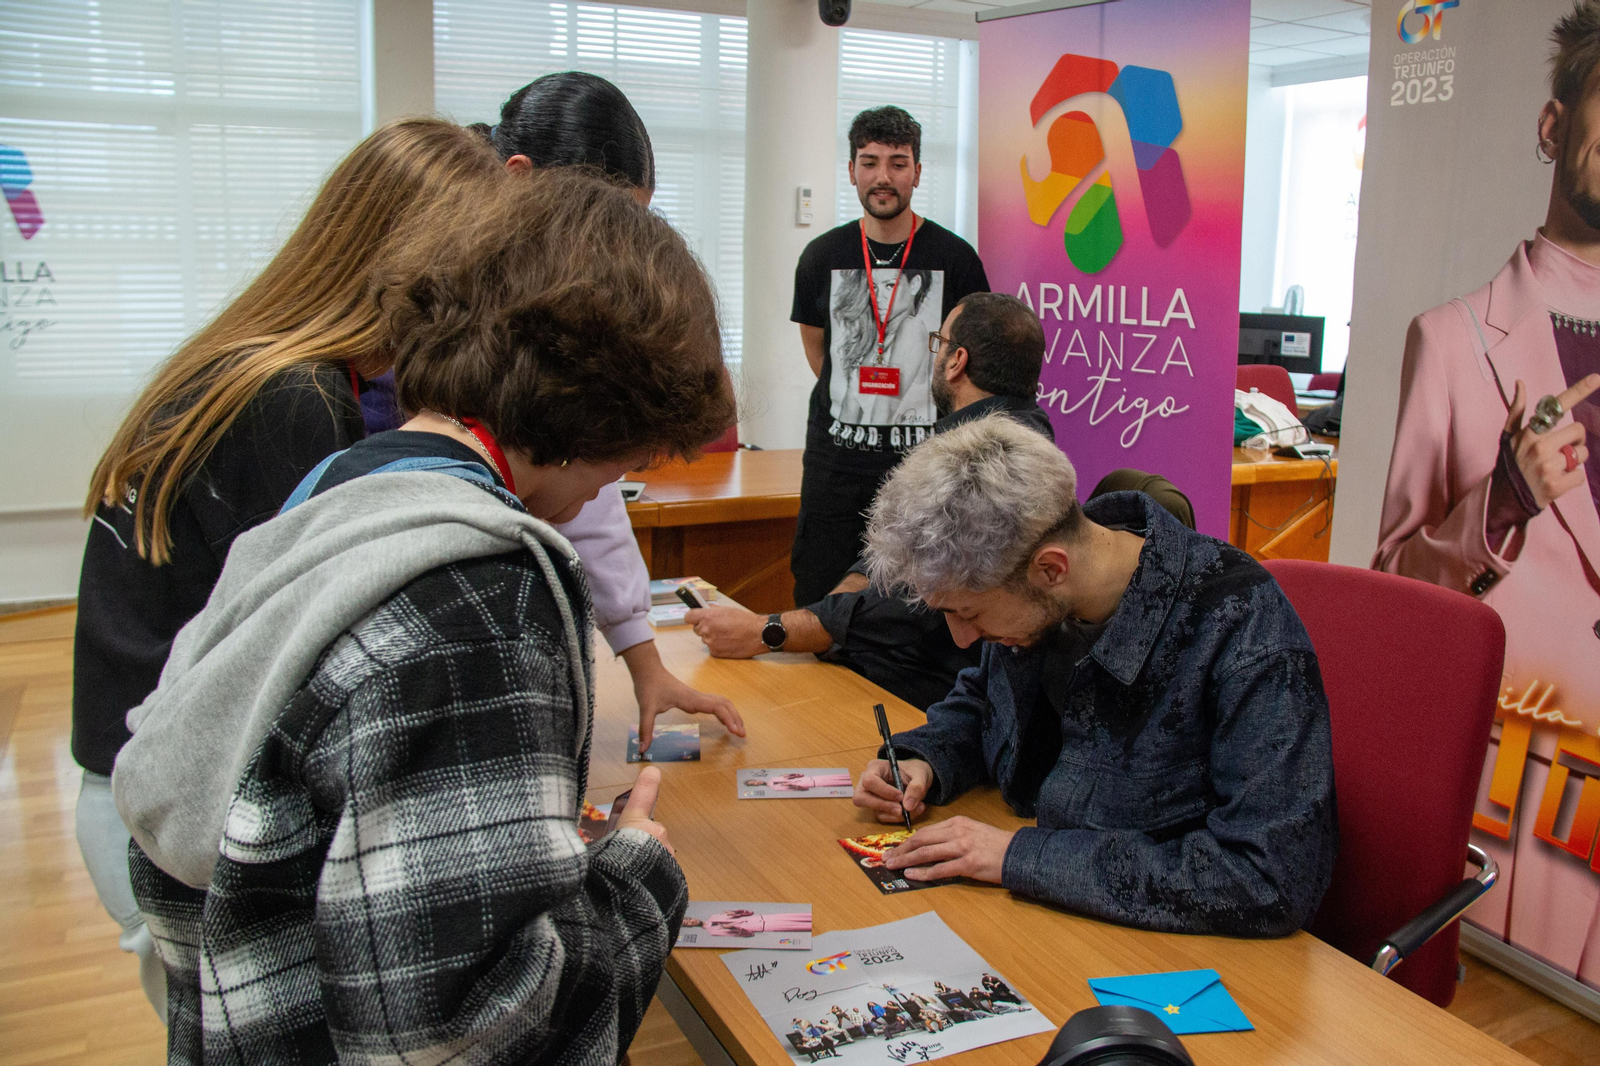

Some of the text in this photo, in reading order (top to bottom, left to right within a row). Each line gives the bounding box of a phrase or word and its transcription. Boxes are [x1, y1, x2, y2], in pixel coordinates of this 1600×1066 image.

[1393, 45, 1456, 65] OPERACIÓN
[1393, 59, 1455, 79] TRIUNFO
[1390, 75, 1454, 106] 2023
[1043, 328, 1194, 378] VANZA
[1036, 357, 1190, 448] ontigo
[1497, 679, 1582, 726] illa
[860, 952, 905, 966] 2023
